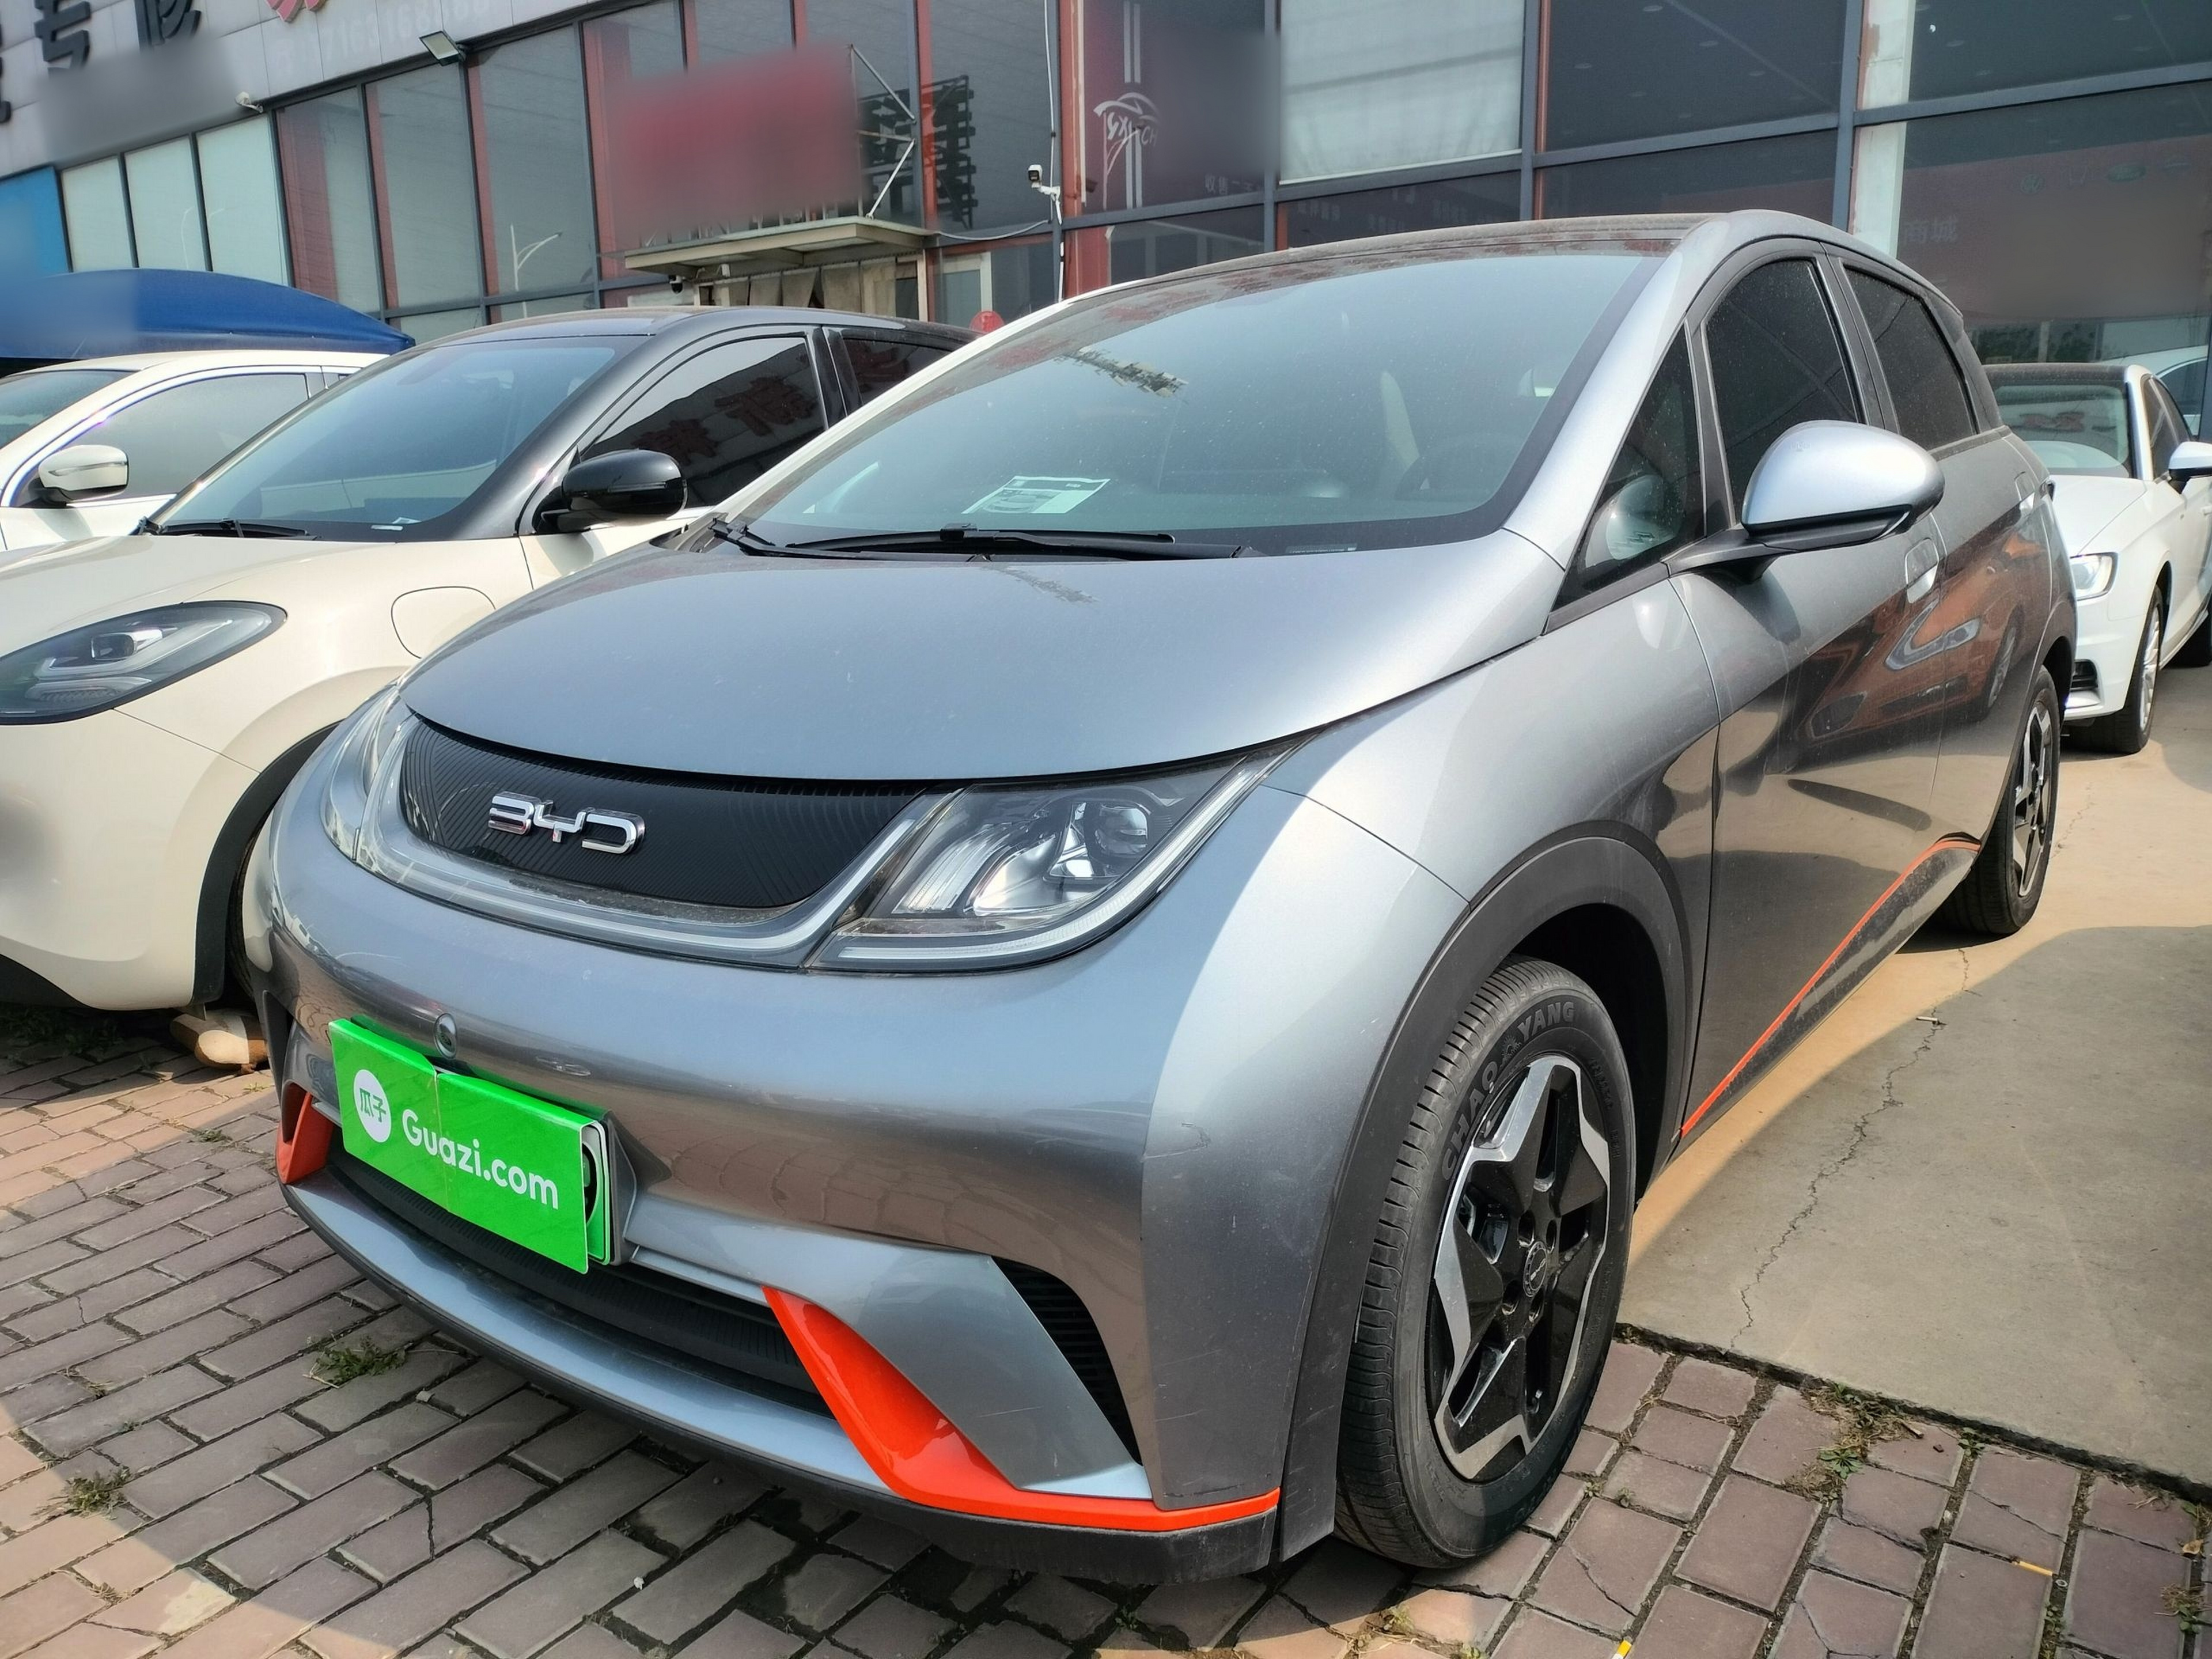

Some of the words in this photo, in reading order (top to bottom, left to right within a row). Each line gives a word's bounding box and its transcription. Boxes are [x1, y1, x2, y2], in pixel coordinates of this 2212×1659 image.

[488, 790, 646, 854] BYD
[1517, 1001, 1574, 1041] YANG
[359, 1087, 387, 1123] 瓜子
[402, 1108, 559, 1210] Guazi.com
